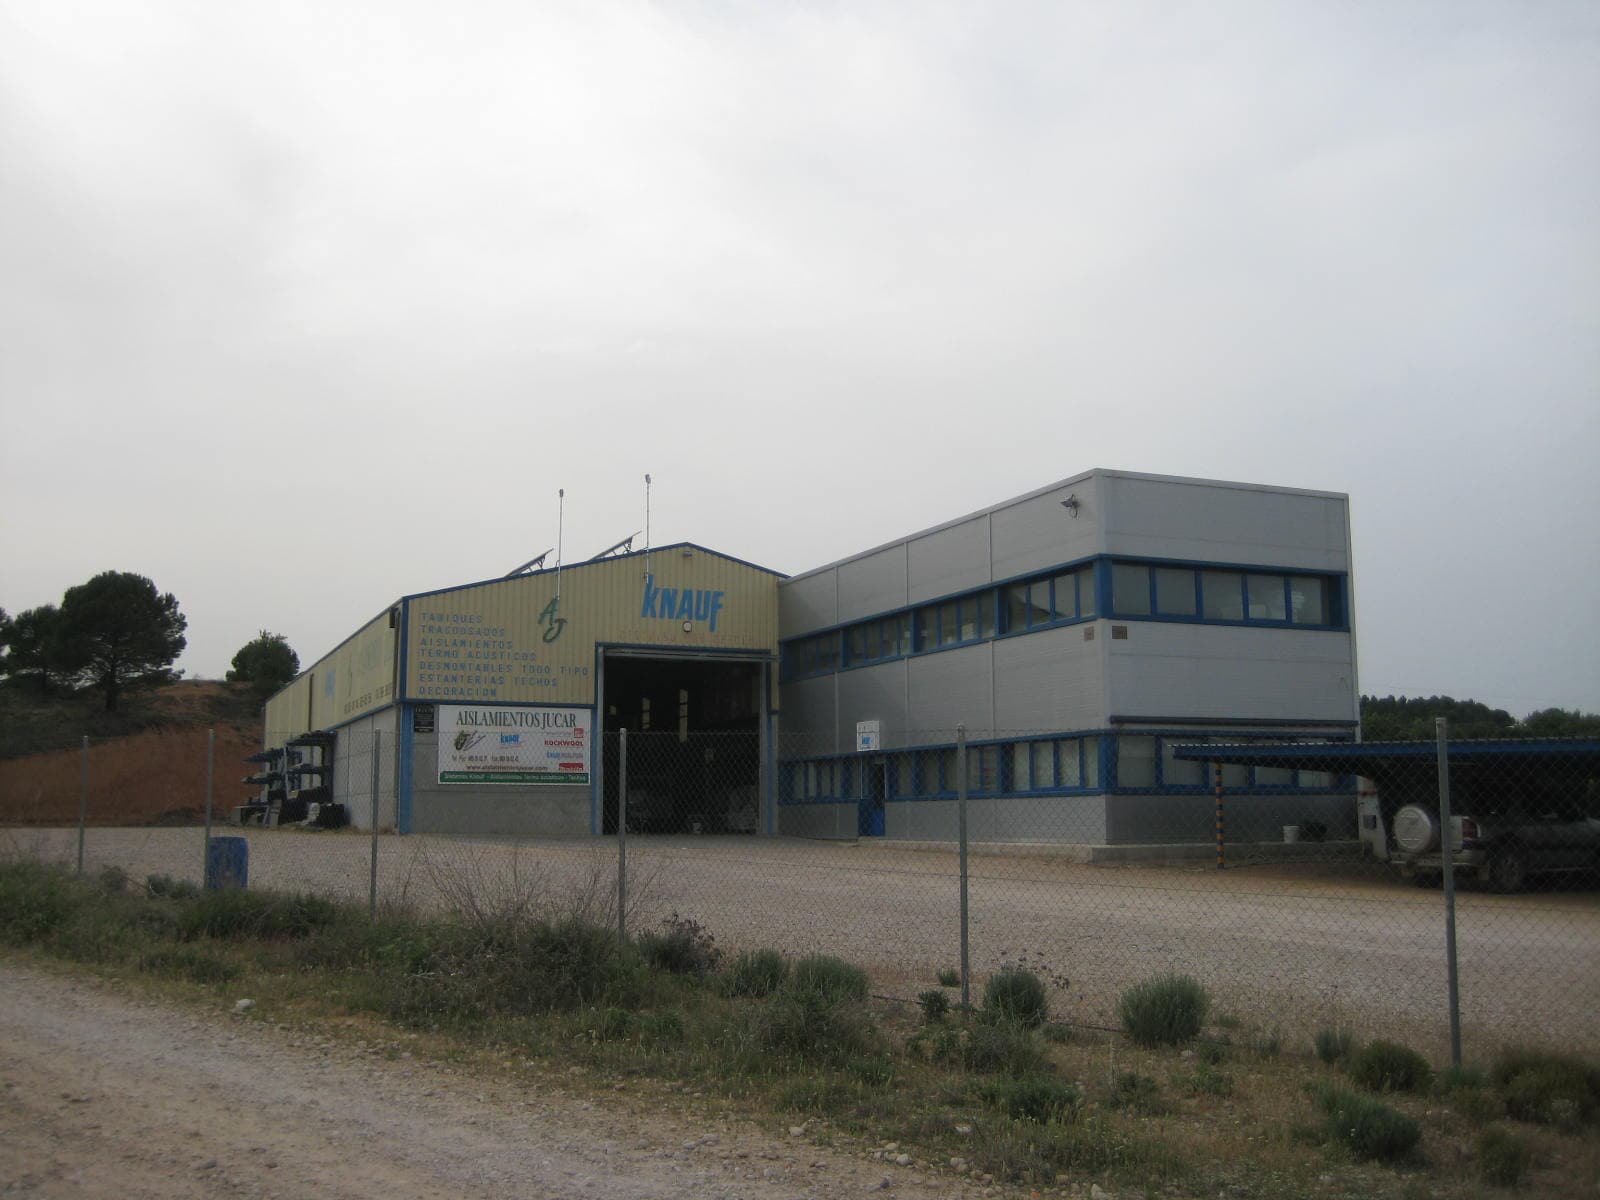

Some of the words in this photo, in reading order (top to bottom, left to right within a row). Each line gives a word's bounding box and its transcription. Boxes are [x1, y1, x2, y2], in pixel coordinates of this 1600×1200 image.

[641, 574, 725, 632] KNAUF
[421, 613, 482, 624] TABIQUES
[420, 638, 513, 649] AISLAMIENTOS
[420, 649, 459, 659] TERMO
[467, 651, 537, 662] ACUSTICOS
[419, 661, 513, 673] DESMONTABLES
[522, 665, 550, 674] TODO
[560, 666, 589, 676] TIPO
[418, 673, 505, 685] ESTANTERIAS
[514, 677, 559, 687] TECHOS
[418, 686, 497, 697] DECORACION
[456, 711, 542, 727] AISLAMIENTOS
[541, 712, 577, 729] JUCAR
